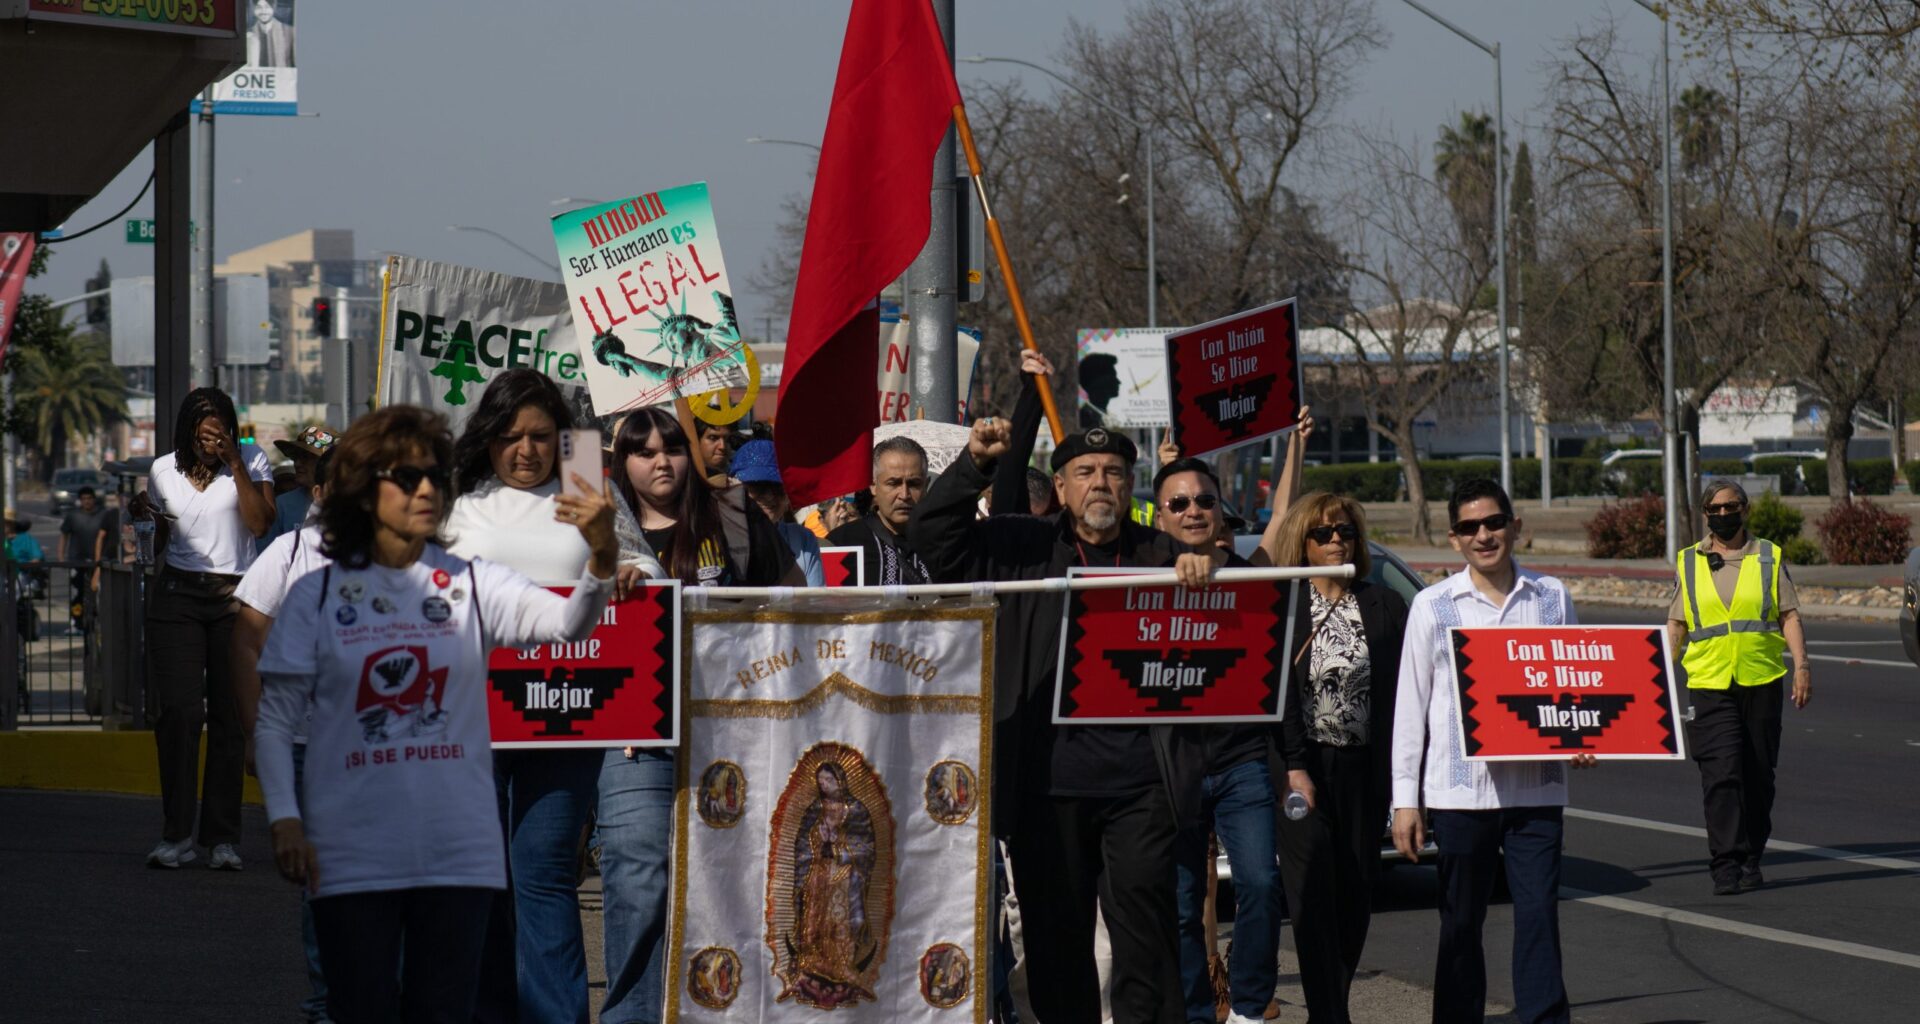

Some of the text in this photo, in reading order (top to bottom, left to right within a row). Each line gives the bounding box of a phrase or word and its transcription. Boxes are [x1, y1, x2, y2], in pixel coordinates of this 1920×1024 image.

[233, 73, 276, 89] ONE
[233, 89, 276, 99] FRESNO
[569, 220, 697, 278] Ser Humano es
[579, 243, 720, 336] ILEGAL
[1201, 324, 1265, 361] Con Unión
[1211, 355, 1258, 384] Se Vive
[1218, 394, 1257, 422] Mejor
[1125, 585, 1237, 611] Con Unión
[1137, 616, 1219, 642] Se Vive
[1506, 639, 1615, 662] Con Unión
[736, 639, 938, 690] REINA DE MEXICO
[1140, 661, 1207, 691] Mejor
[1524, 665, 1604, 688] Se Vive
[525, 681, 594, 714] Mejor
[1537, 704, 1601, 731] Mejor
[372, 748, 397, 765] SE
